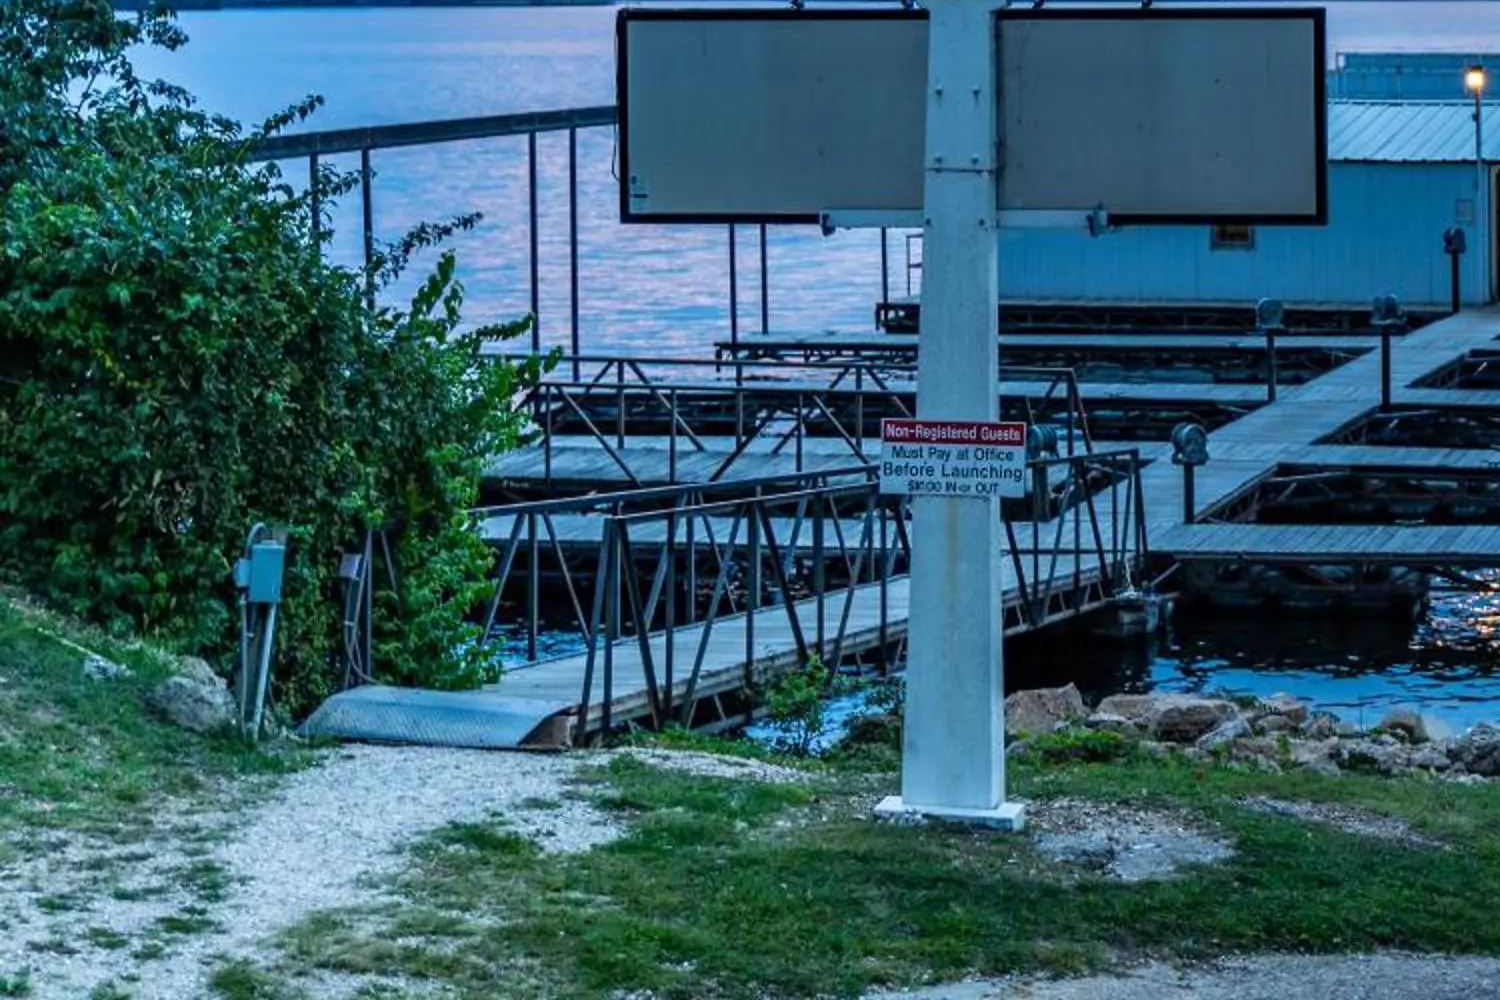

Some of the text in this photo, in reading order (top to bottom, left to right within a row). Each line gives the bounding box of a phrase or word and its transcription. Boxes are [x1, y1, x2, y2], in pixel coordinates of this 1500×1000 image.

[885, 423, 1021, 441] Non-Registered Guests
[891, 446, 1014, 462] Must Pay at Office
[883, 461, 1023, 482] Before Launching
[975, 482, 1000, 494] OUT
